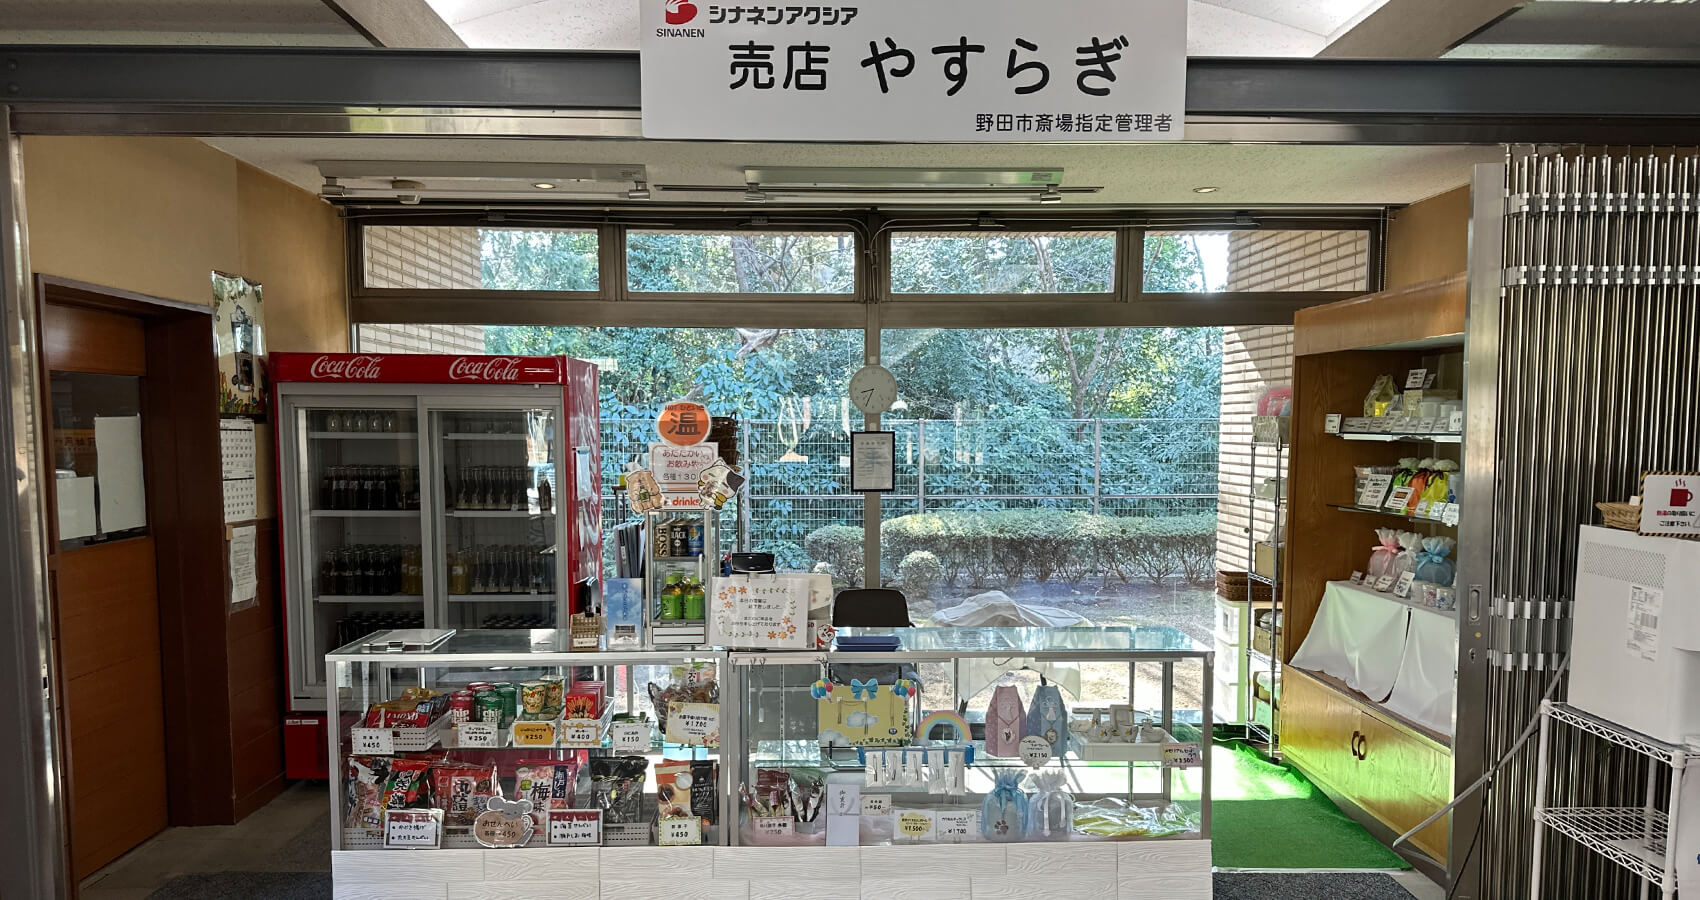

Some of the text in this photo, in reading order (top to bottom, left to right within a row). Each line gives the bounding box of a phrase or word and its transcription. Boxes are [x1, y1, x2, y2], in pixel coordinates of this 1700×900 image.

[708, 5, 858, 26] シナネンアクシア
[656, 28, 704, 38] SINANEN
[728, 35, 1129, 97] 売店 やすらぎ
[975, 113, 1173, 134] 野田市斎場指定管理者
[310, 355, 384, 379] Coca-Cola
[449, 357, 523, 381] Coca-Cola
[668, 412, 700, 435] 温
[658, 528, 668, 556] BOSS
[530, 781, 551, 813] 梅味
